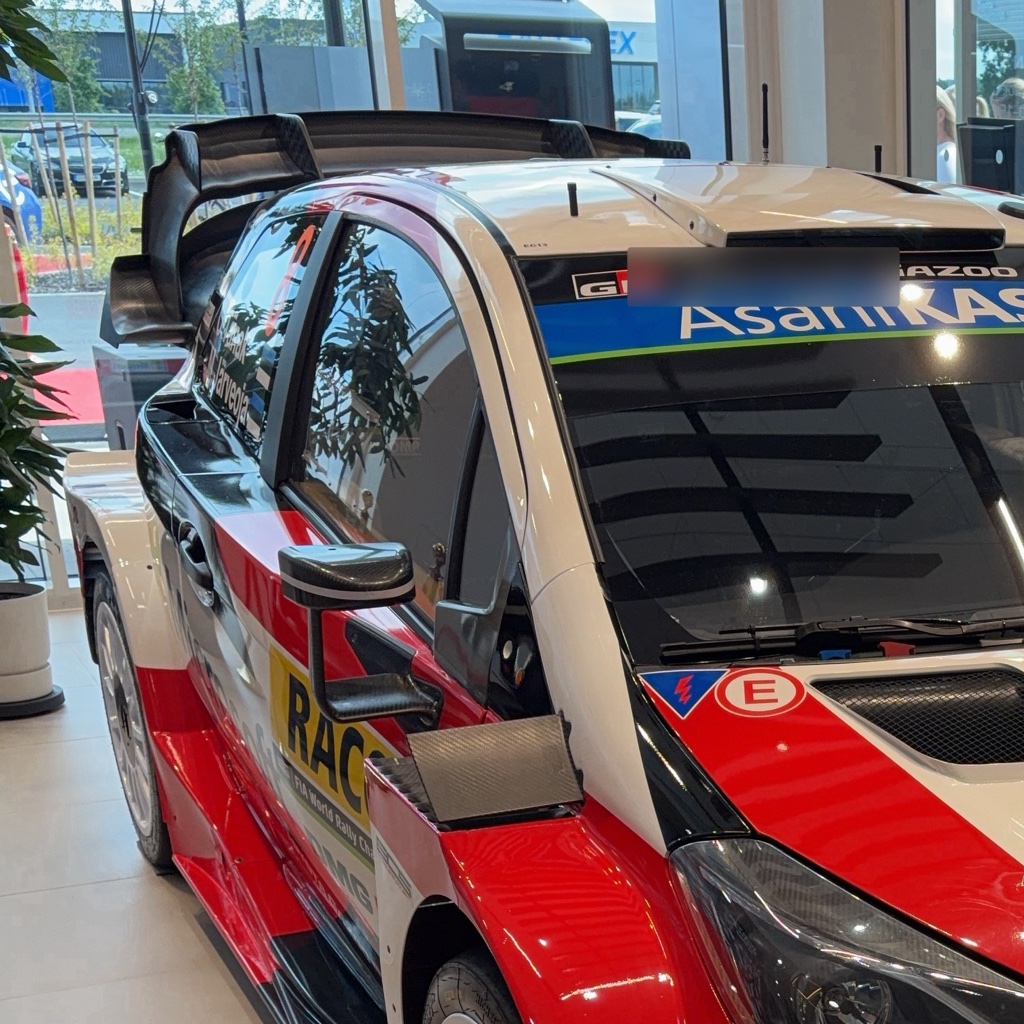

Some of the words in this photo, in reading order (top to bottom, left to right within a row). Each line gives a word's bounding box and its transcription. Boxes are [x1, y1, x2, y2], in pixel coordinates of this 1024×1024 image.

[743, 679, 779, 705] E
[287, 672, 388, 816] RAC
[294, 777, 309, 798] FIA
[310, 790, 334, 823] World
[335, 815, 358, 847] Rally
